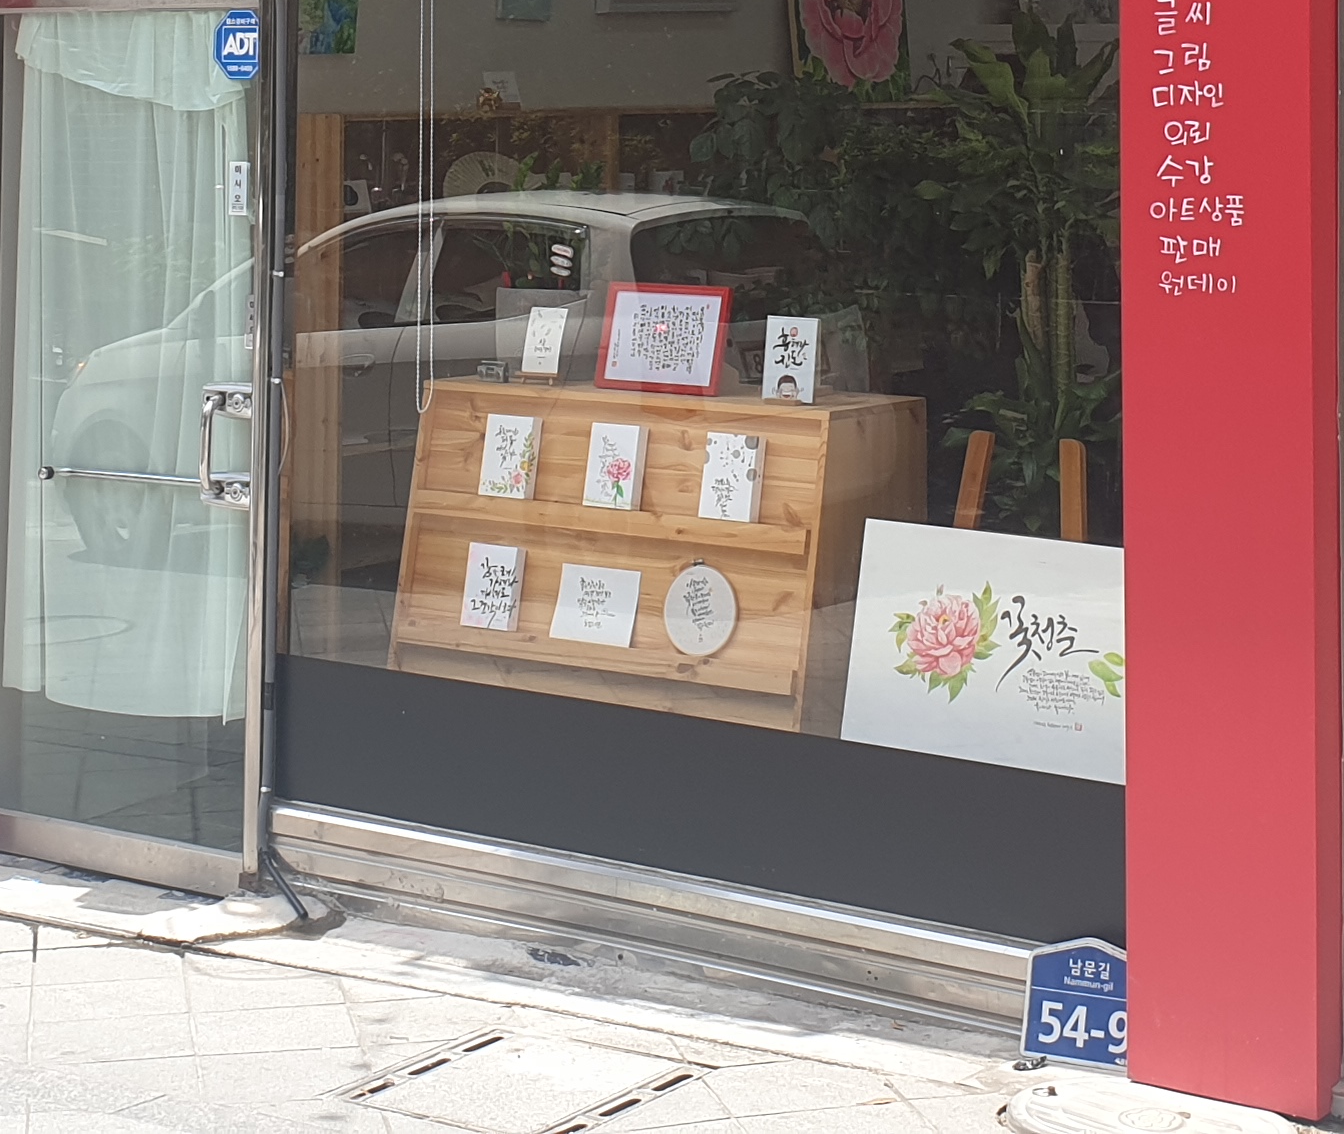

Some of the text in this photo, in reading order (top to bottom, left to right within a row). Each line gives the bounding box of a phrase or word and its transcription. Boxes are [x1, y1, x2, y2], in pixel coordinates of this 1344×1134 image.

[223, 32, 258, 56] ADT
[1153, 43, 1211, 74] 그림
[1152, 81, 1224, 108] 디자인
[1164, 120, 1211, 146] 의뢰
[1157, 155, 1213, 187] 수강
[1150, 195, 1244, 226] 아트상품
[1159, 235, 1221, 263] 판매
[1158, 271, 1236, 296] 원데이
[1069, 958, 1110, 980] 남문길
[1063, 976, 1114, 992] Nammun-gil
[1037, 1000, 1127, 1054] 54-9
